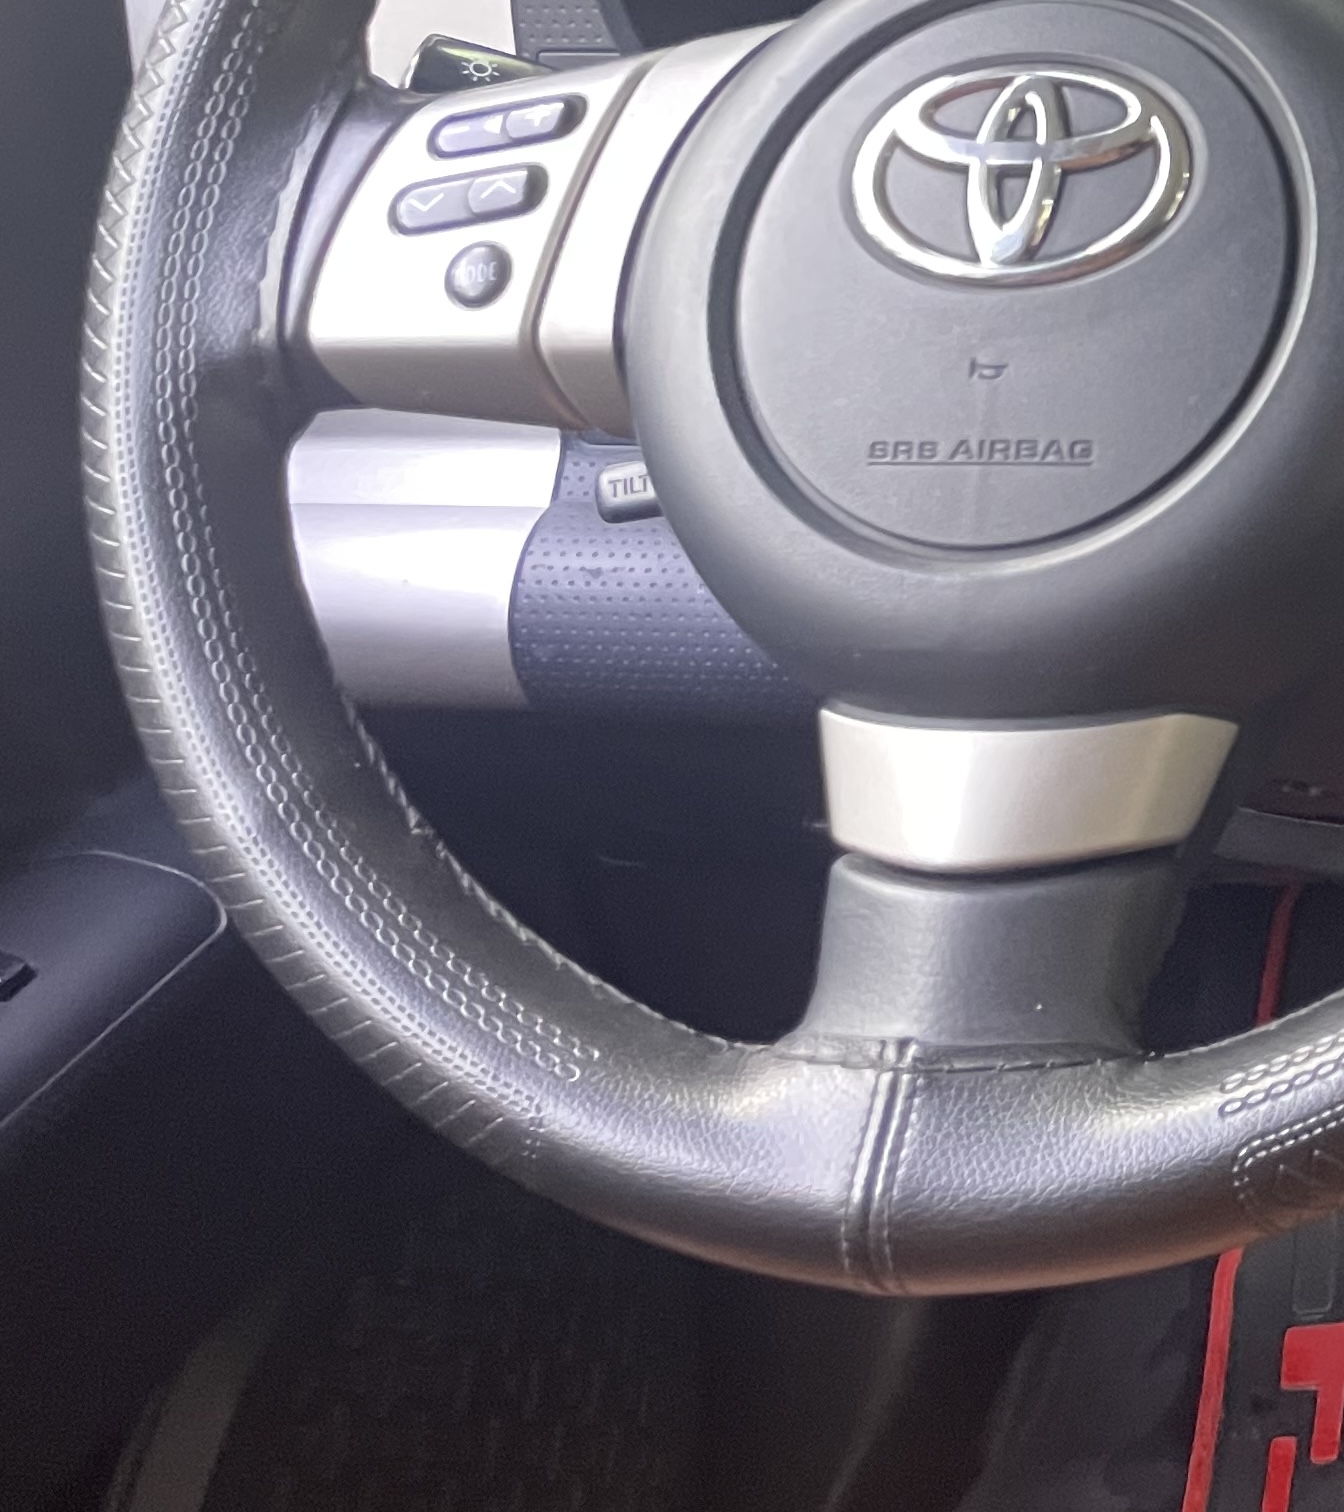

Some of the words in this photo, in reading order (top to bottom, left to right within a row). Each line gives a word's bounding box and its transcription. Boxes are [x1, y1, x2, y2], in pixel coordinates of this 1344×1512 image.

[867, 440, 938, 460] SRS
[948, 439, 1094, 461] AIRBAG
[608, 473, 650, 498] TILT
